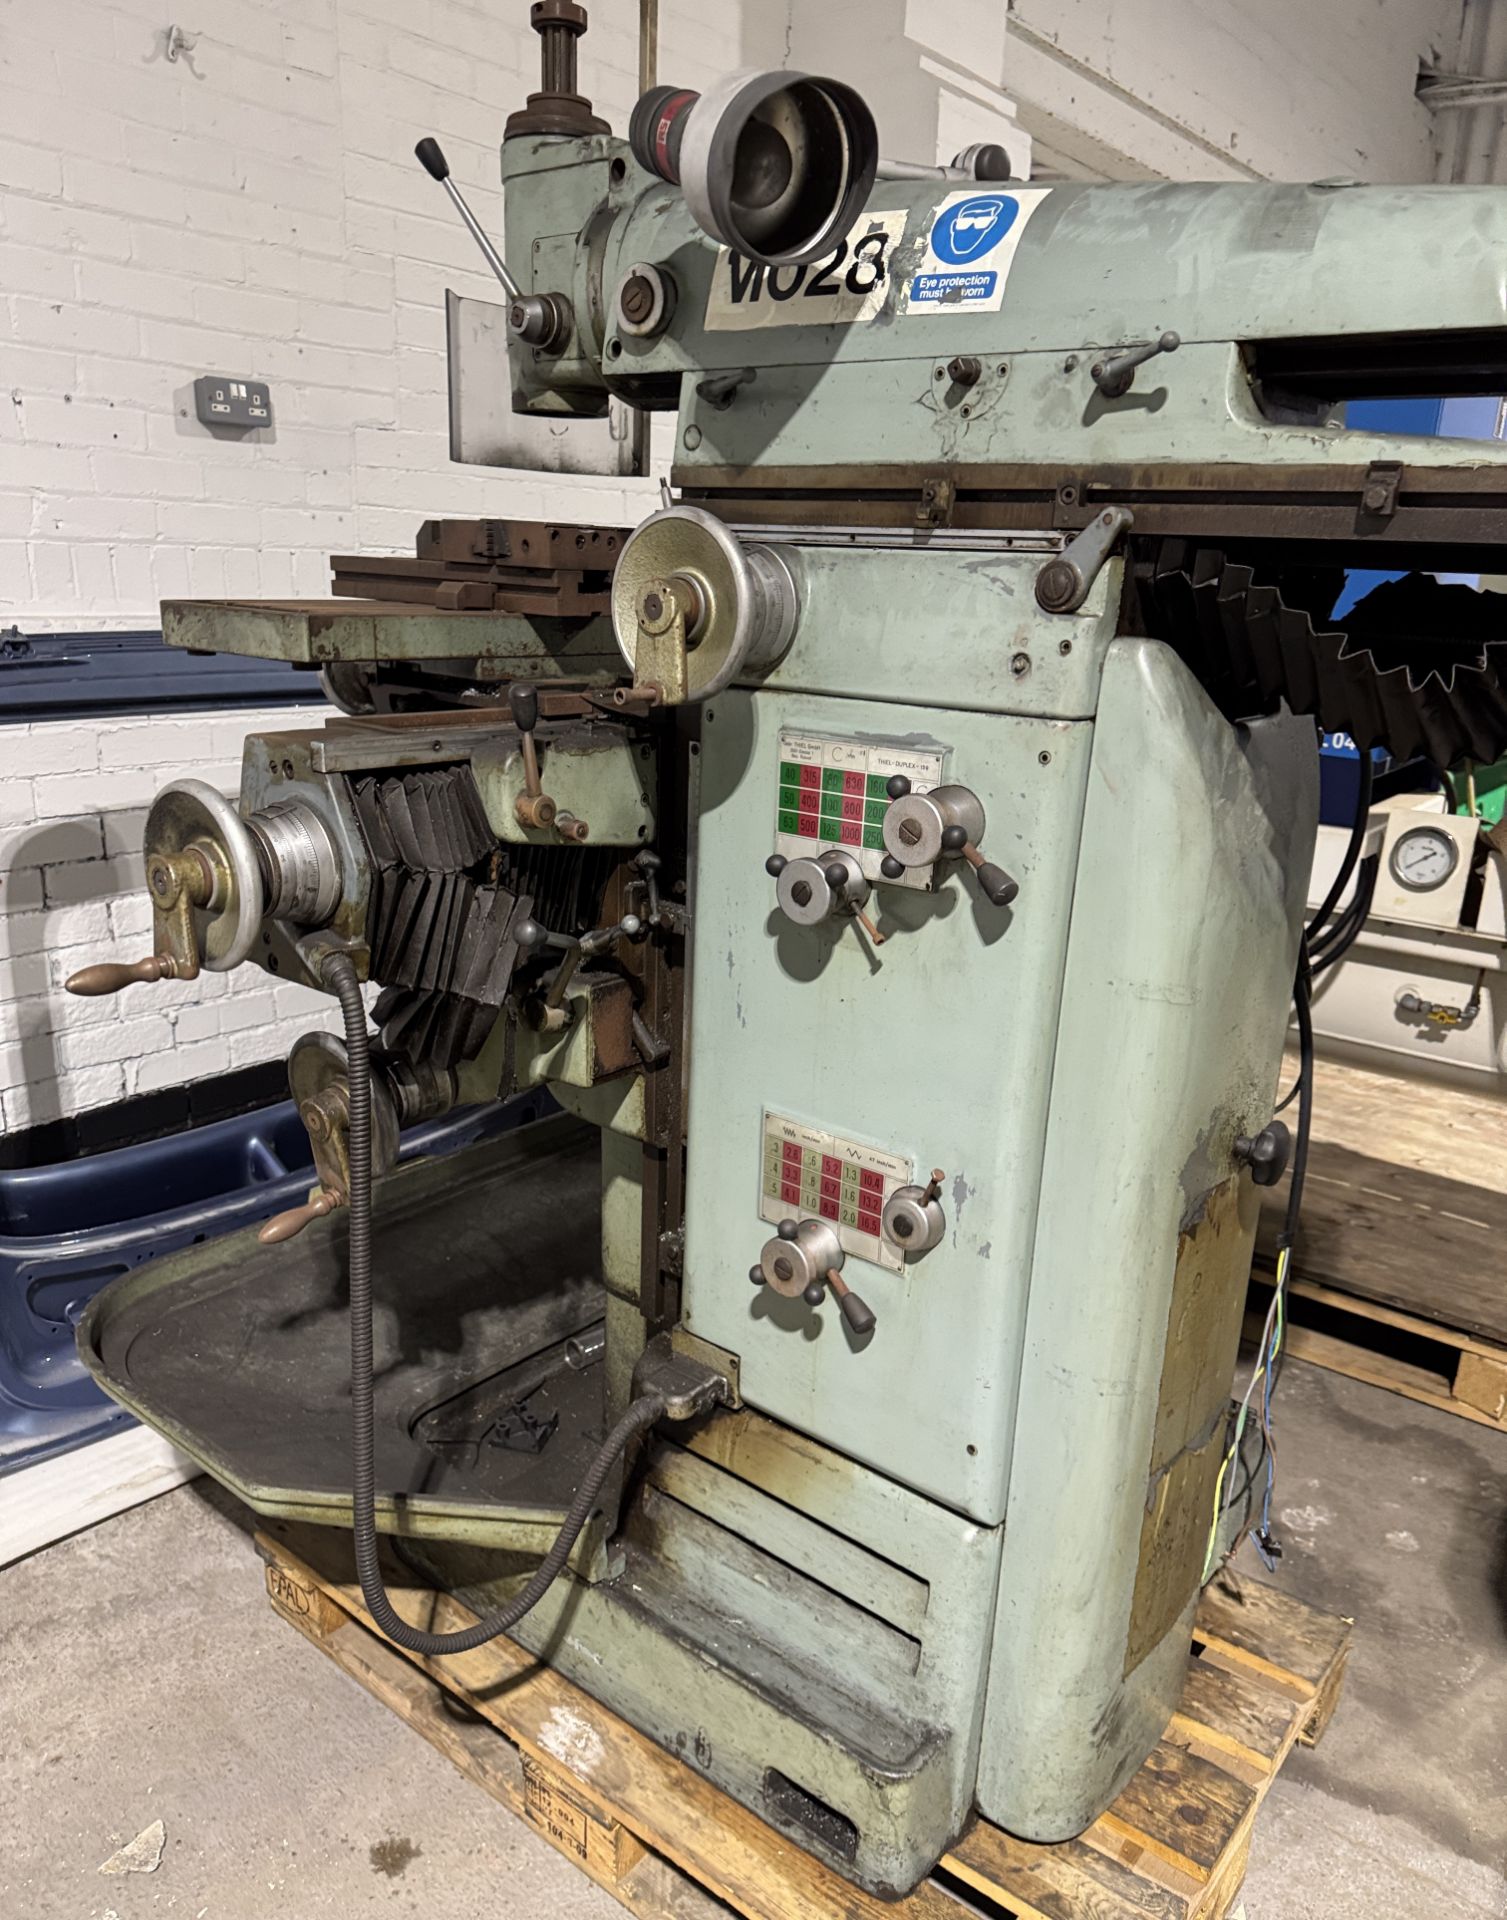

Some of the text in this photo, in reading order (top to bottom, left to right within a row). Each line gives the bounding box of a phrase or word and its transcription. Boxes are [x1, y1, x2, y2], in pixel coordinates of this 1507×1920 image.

[920, 275, 990, 290] Eye protection
[920, 289, 943, 298] must
[785, 768, 795, 780] 40
[804, 770, 817, 783] 315
[846, 777, 862, 790] 630
[870, 781, 884, 793] 160
[784, 792, 883, 819] 50 400 100 800 200
[783, 816, 881, 844] 63 500 125 1000 250
[770, 1162, 778, 1174] .4
[808, 1176, 816, 1187] .8
[845, 1189, 856, 1202] 1.6
[863, 1195, 878, 1211] 13.2
[809, 1156, 816, 1166] .6
[826, 1160, 839, 1175] 5.2
[846, 1167, 857, 1181] 1.3
[864, 1173, 880, 1189] 10.4
[806, 1196, 816, 1208] 1.0
[843, 1210, 855, 1223] 2.0
[861, 1217, 877, 1232] 16.5
[270, 1569, 303, 1611] EPAL
